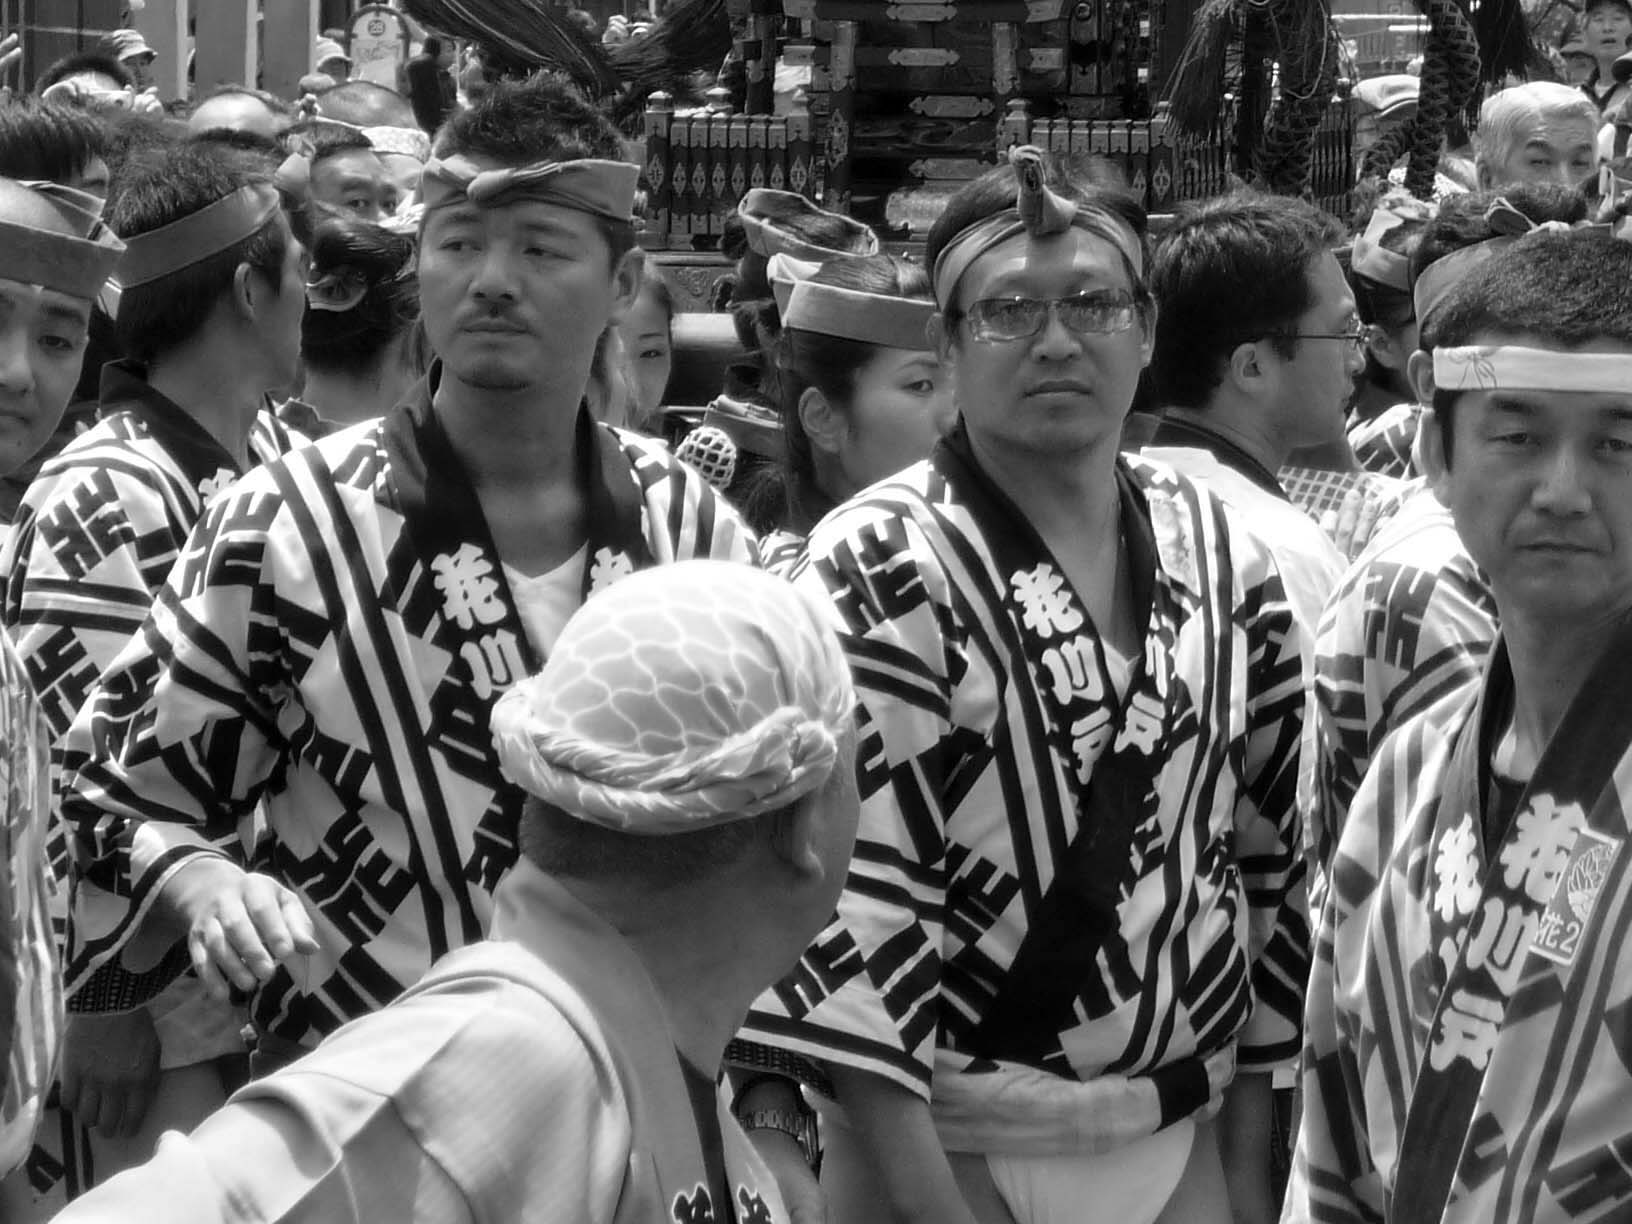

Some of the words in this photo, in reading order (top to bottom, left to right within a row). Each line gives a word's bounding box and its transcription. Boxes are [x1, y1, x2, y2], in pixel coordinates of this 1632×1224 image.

[1010, 562, 1114, 786] 花川戸
[1430, 792, 1588, 1074] 花川戸
